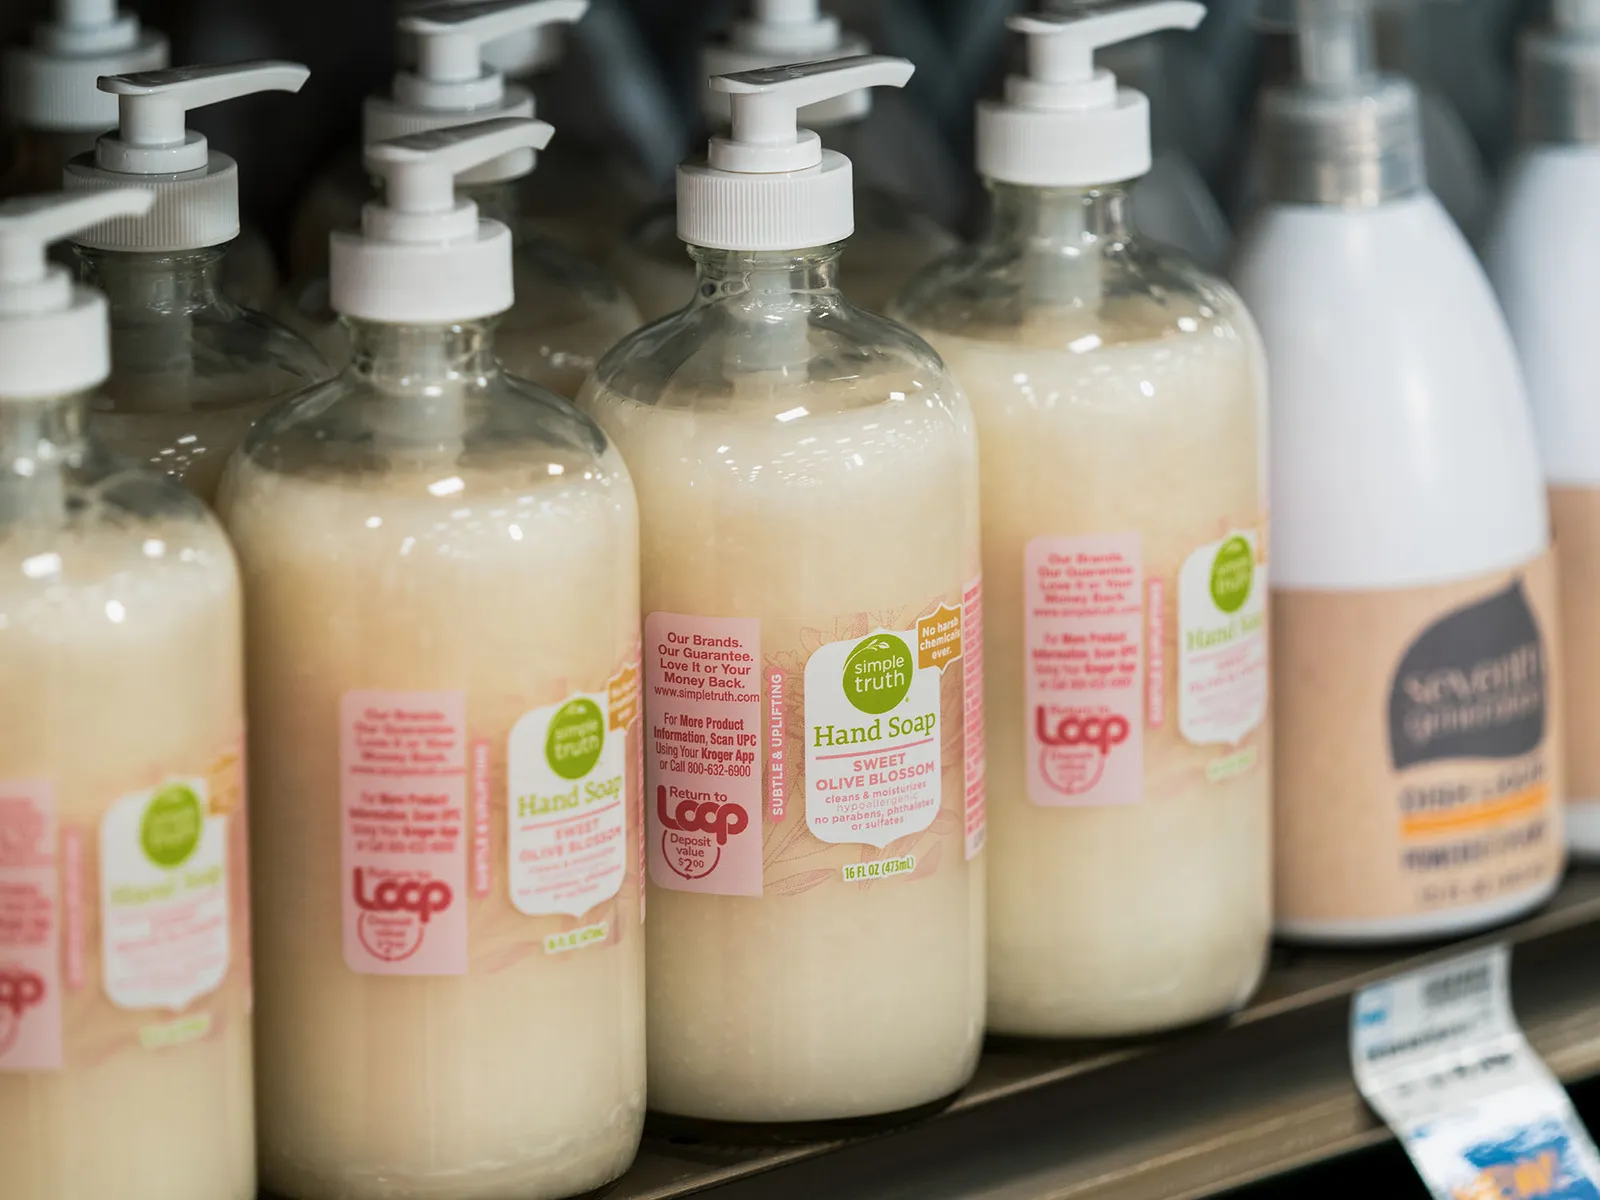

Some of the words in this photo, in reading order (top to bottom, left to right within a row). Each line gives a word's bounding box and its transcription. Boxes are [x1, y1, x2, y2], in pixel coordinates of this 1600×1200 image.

[667, 632, 689, 644] Our
[693, 635, 743, 648] Brands.
[922, 627, 936, 638] No
[658, 644, 680, 657] Our
[683, 647, 754, 662] Guarantee.
[931, 646, 952, 660] ever.
[660, 658, 688, 672] Love
[692, 662, 701, 673] It
[704, 665, 718, 674] or
[721, 664, 751, 676] Your
[854, 655, 905, 675] simple
[664, 672, 705, 688] Money
[708, 676, 745, 689] Back.
[854, 669, 905, 693] truth
[654, 686, 760, 702] www.simpletruth.com
[771, 673, 783, 748] UPLIFTING
[664, 712, 678, 725] For
[680, 714, 704, 728] More
[706, 717, 744, 731] Product
[813, 718, 882, 747] Hand
[888, 712, 936, 738] Soap
[1036, 704, 1130, 756] Loop
[653, 726, 708, 746] Information,
[710, 732, 734, 746] Scan
[736, 734, 757, 747] UPC
[656, 742, 678, 759] Using
[680, 745, 699, 758] Your
[701, 747, 733, 763] Kroger
[735, 749, 755, 764] App
[772, 750, 783, 761] &
[853, 752, 906, 772] SWEET
[660, 760, 668, 770] or
[670, 759, 686, 773] Call
[687, 761, 751, 777] 800-632-6900
[815, 775, 865, 791] OLIVE
[869, 761, 935, 786] BLOSSOM
[669, 786, 711, 801] Return
[714, 792, 728, 802] to
[772, 763, 784, 816] SUBTLE
[825, 794, 860, 804] cleans
[862, 790, 870, 800] &
[872, 780, 927, 798] moisturizes
[517, 785, 579, 818] Hand
[814, 816, 829, 825] no
[832, 809, 884, 825] parabens,
[887, 798, 935, 817] phthalates
[836, 792, 919, 813] hypoallergenic
[656, 784, 749, 846] Loop
[851, 822, 862, 831] or
[865, 816, 905, 829] sulfates
[670, 833, 712, 847] Deposit
[676, 846, 705, 857] value
[845, 867, 855, 879] 16
[857, 865, 867, 877] FL
[869, 862, 880, 875] OZ
[882, 857, 915, 875] (473mL)
[353, 866, 454, 924] Loop
